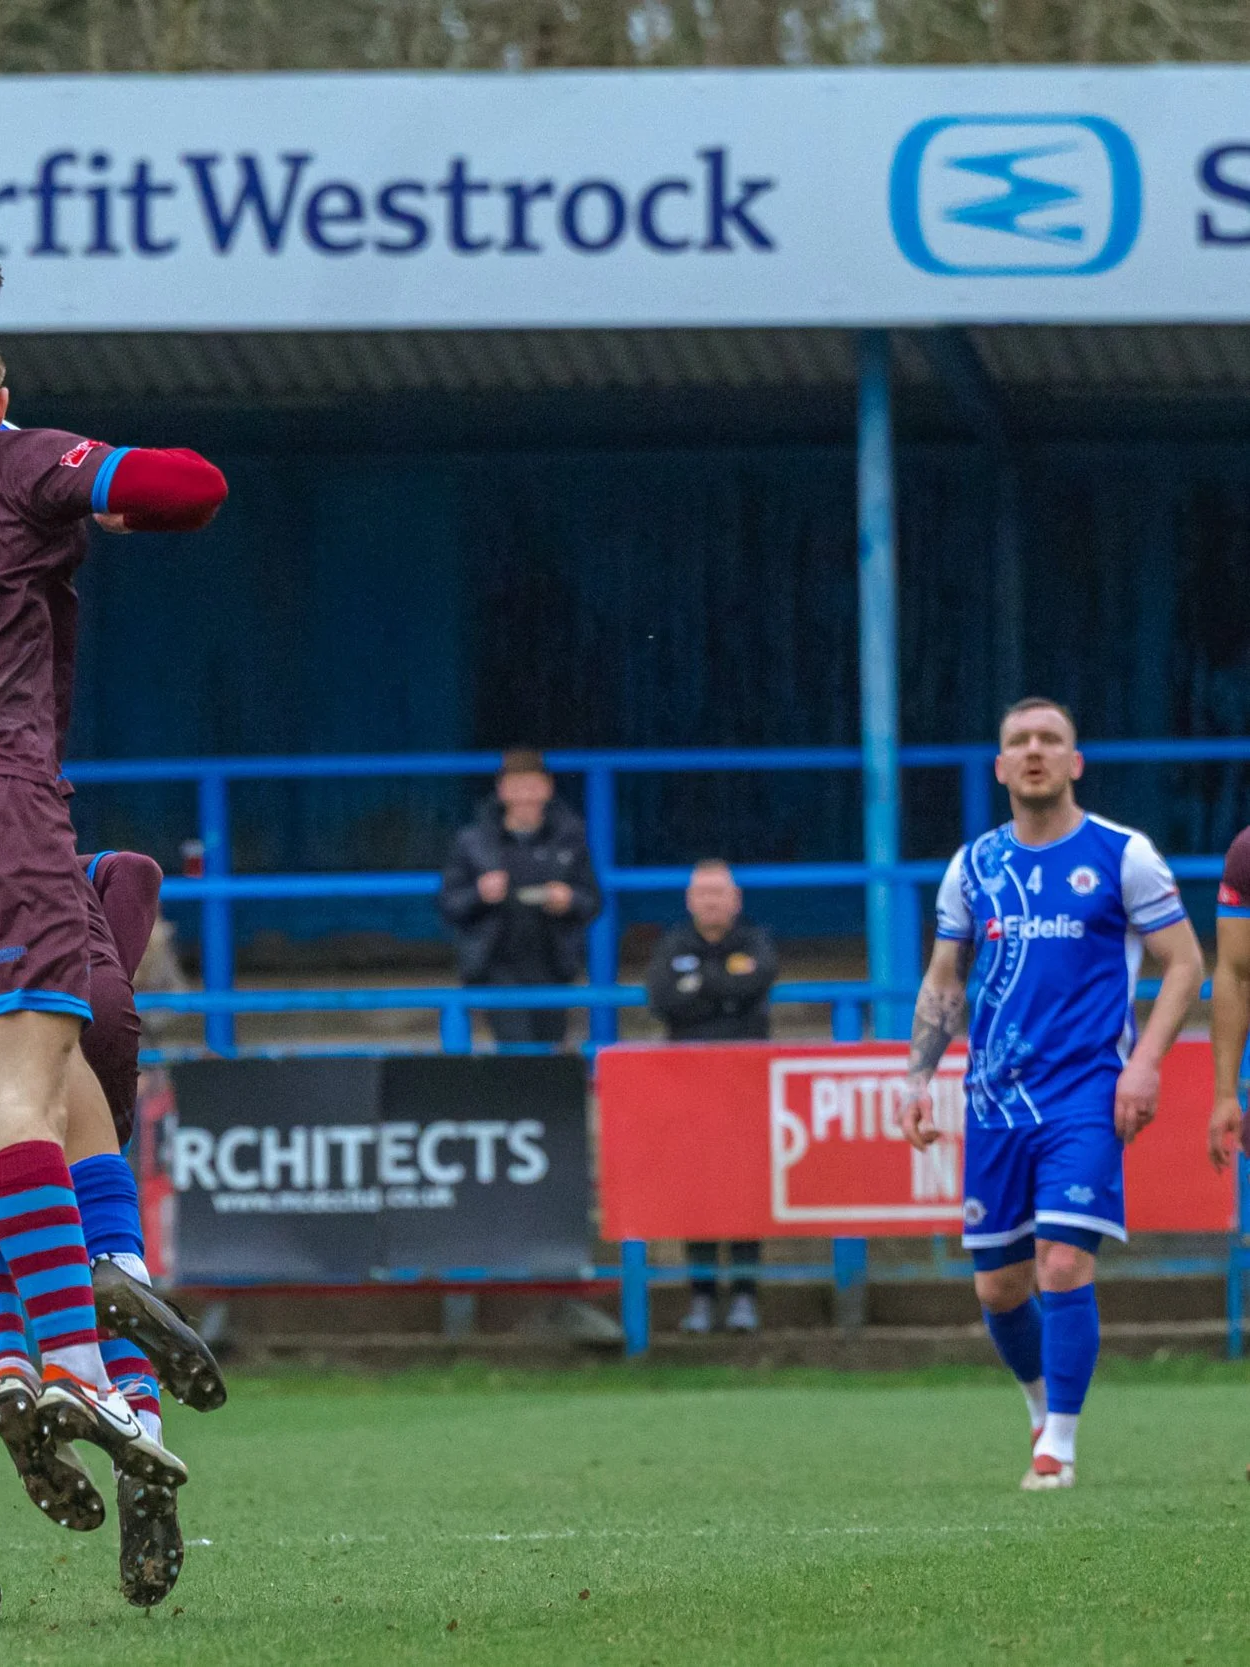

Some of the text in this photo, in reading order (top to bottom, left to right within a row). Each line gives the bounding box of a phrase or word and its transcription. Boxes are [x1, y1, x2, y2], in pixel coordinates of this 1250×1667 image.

[1026, 864, 1043, 895] 4
[1003, 914, 1085, 940] Fidelis
[172, 1120, 550, 1191] RCHITECTS
